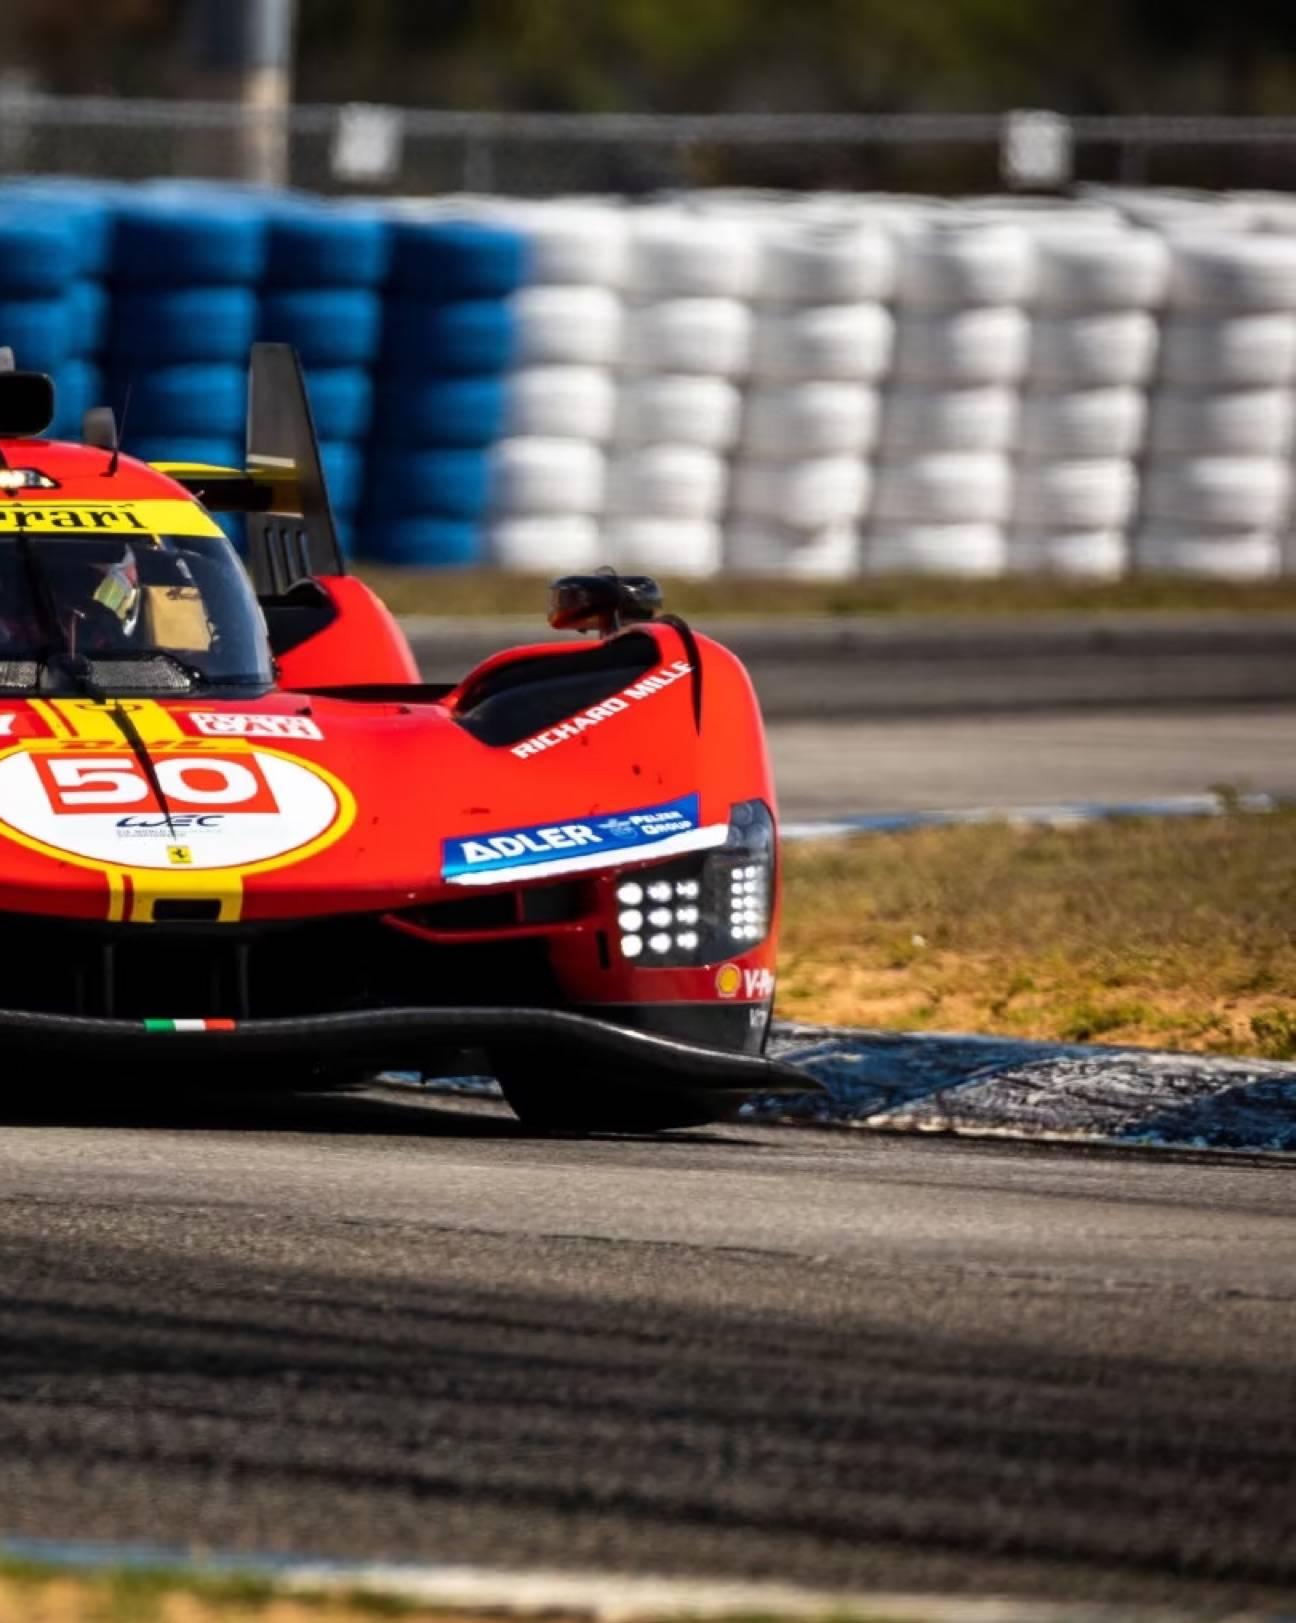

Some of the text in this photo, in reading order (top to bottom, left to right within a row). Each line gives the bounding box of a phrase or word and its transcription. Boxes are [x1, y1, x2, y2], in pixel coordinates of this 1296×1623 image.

[510, 661, 695, 759] RICHARD MILLE
[47, 758, 258, 806] 50
[115, 814, 225, 827] WEC
[460, 824, 603, 864] ADLER
